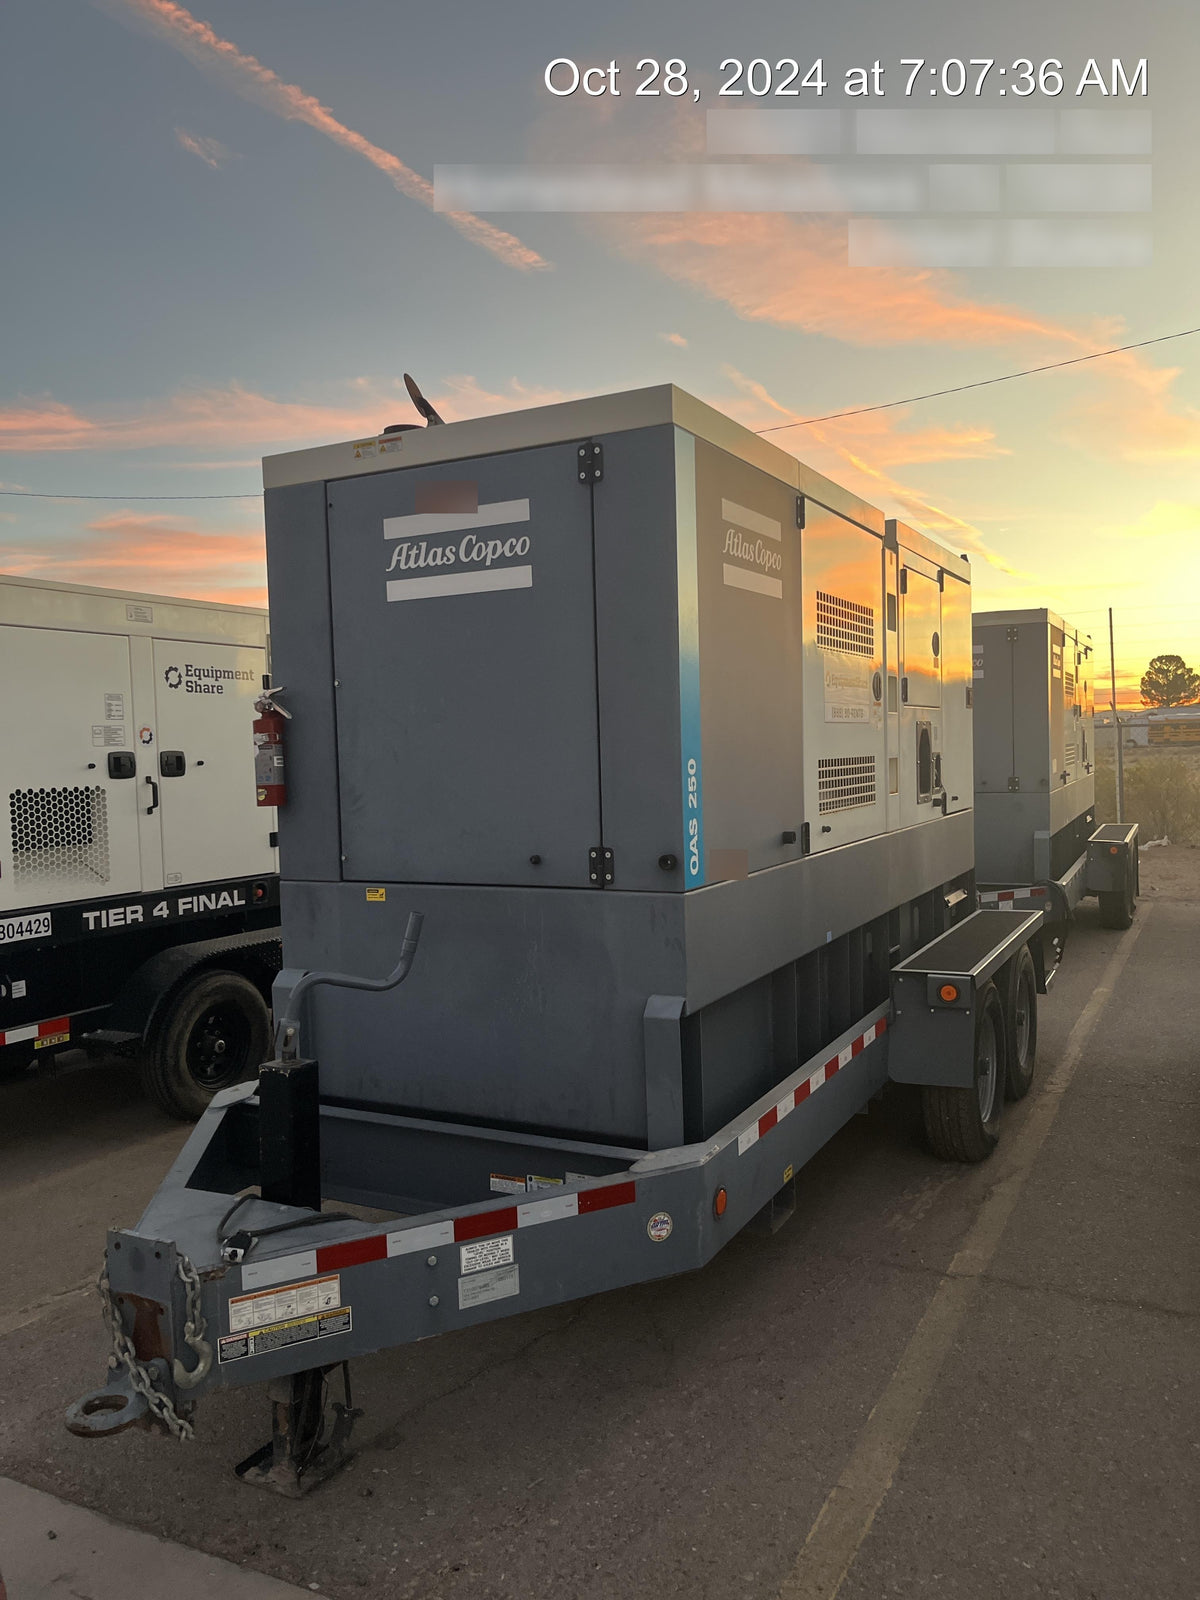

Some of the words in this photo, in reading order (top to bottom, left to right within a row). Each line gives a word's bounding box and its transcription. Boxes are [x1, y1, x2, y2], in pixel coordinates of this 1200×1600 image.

[386, 541, 456, 571] Atlas
[459, 535, 530, 566] Copco
[723, 529, 754, 562] Atlas
[755, 539, 781, 572] Copco
[185, 664, 254, 682] Equipment
[185, 681, 223, 694] Share
[687, 758, 698, 809] 250
[82, 905, 144, 930] TIER
[153, 901, 169, 918] 4
[178, 890, 246, 915] FINAL
